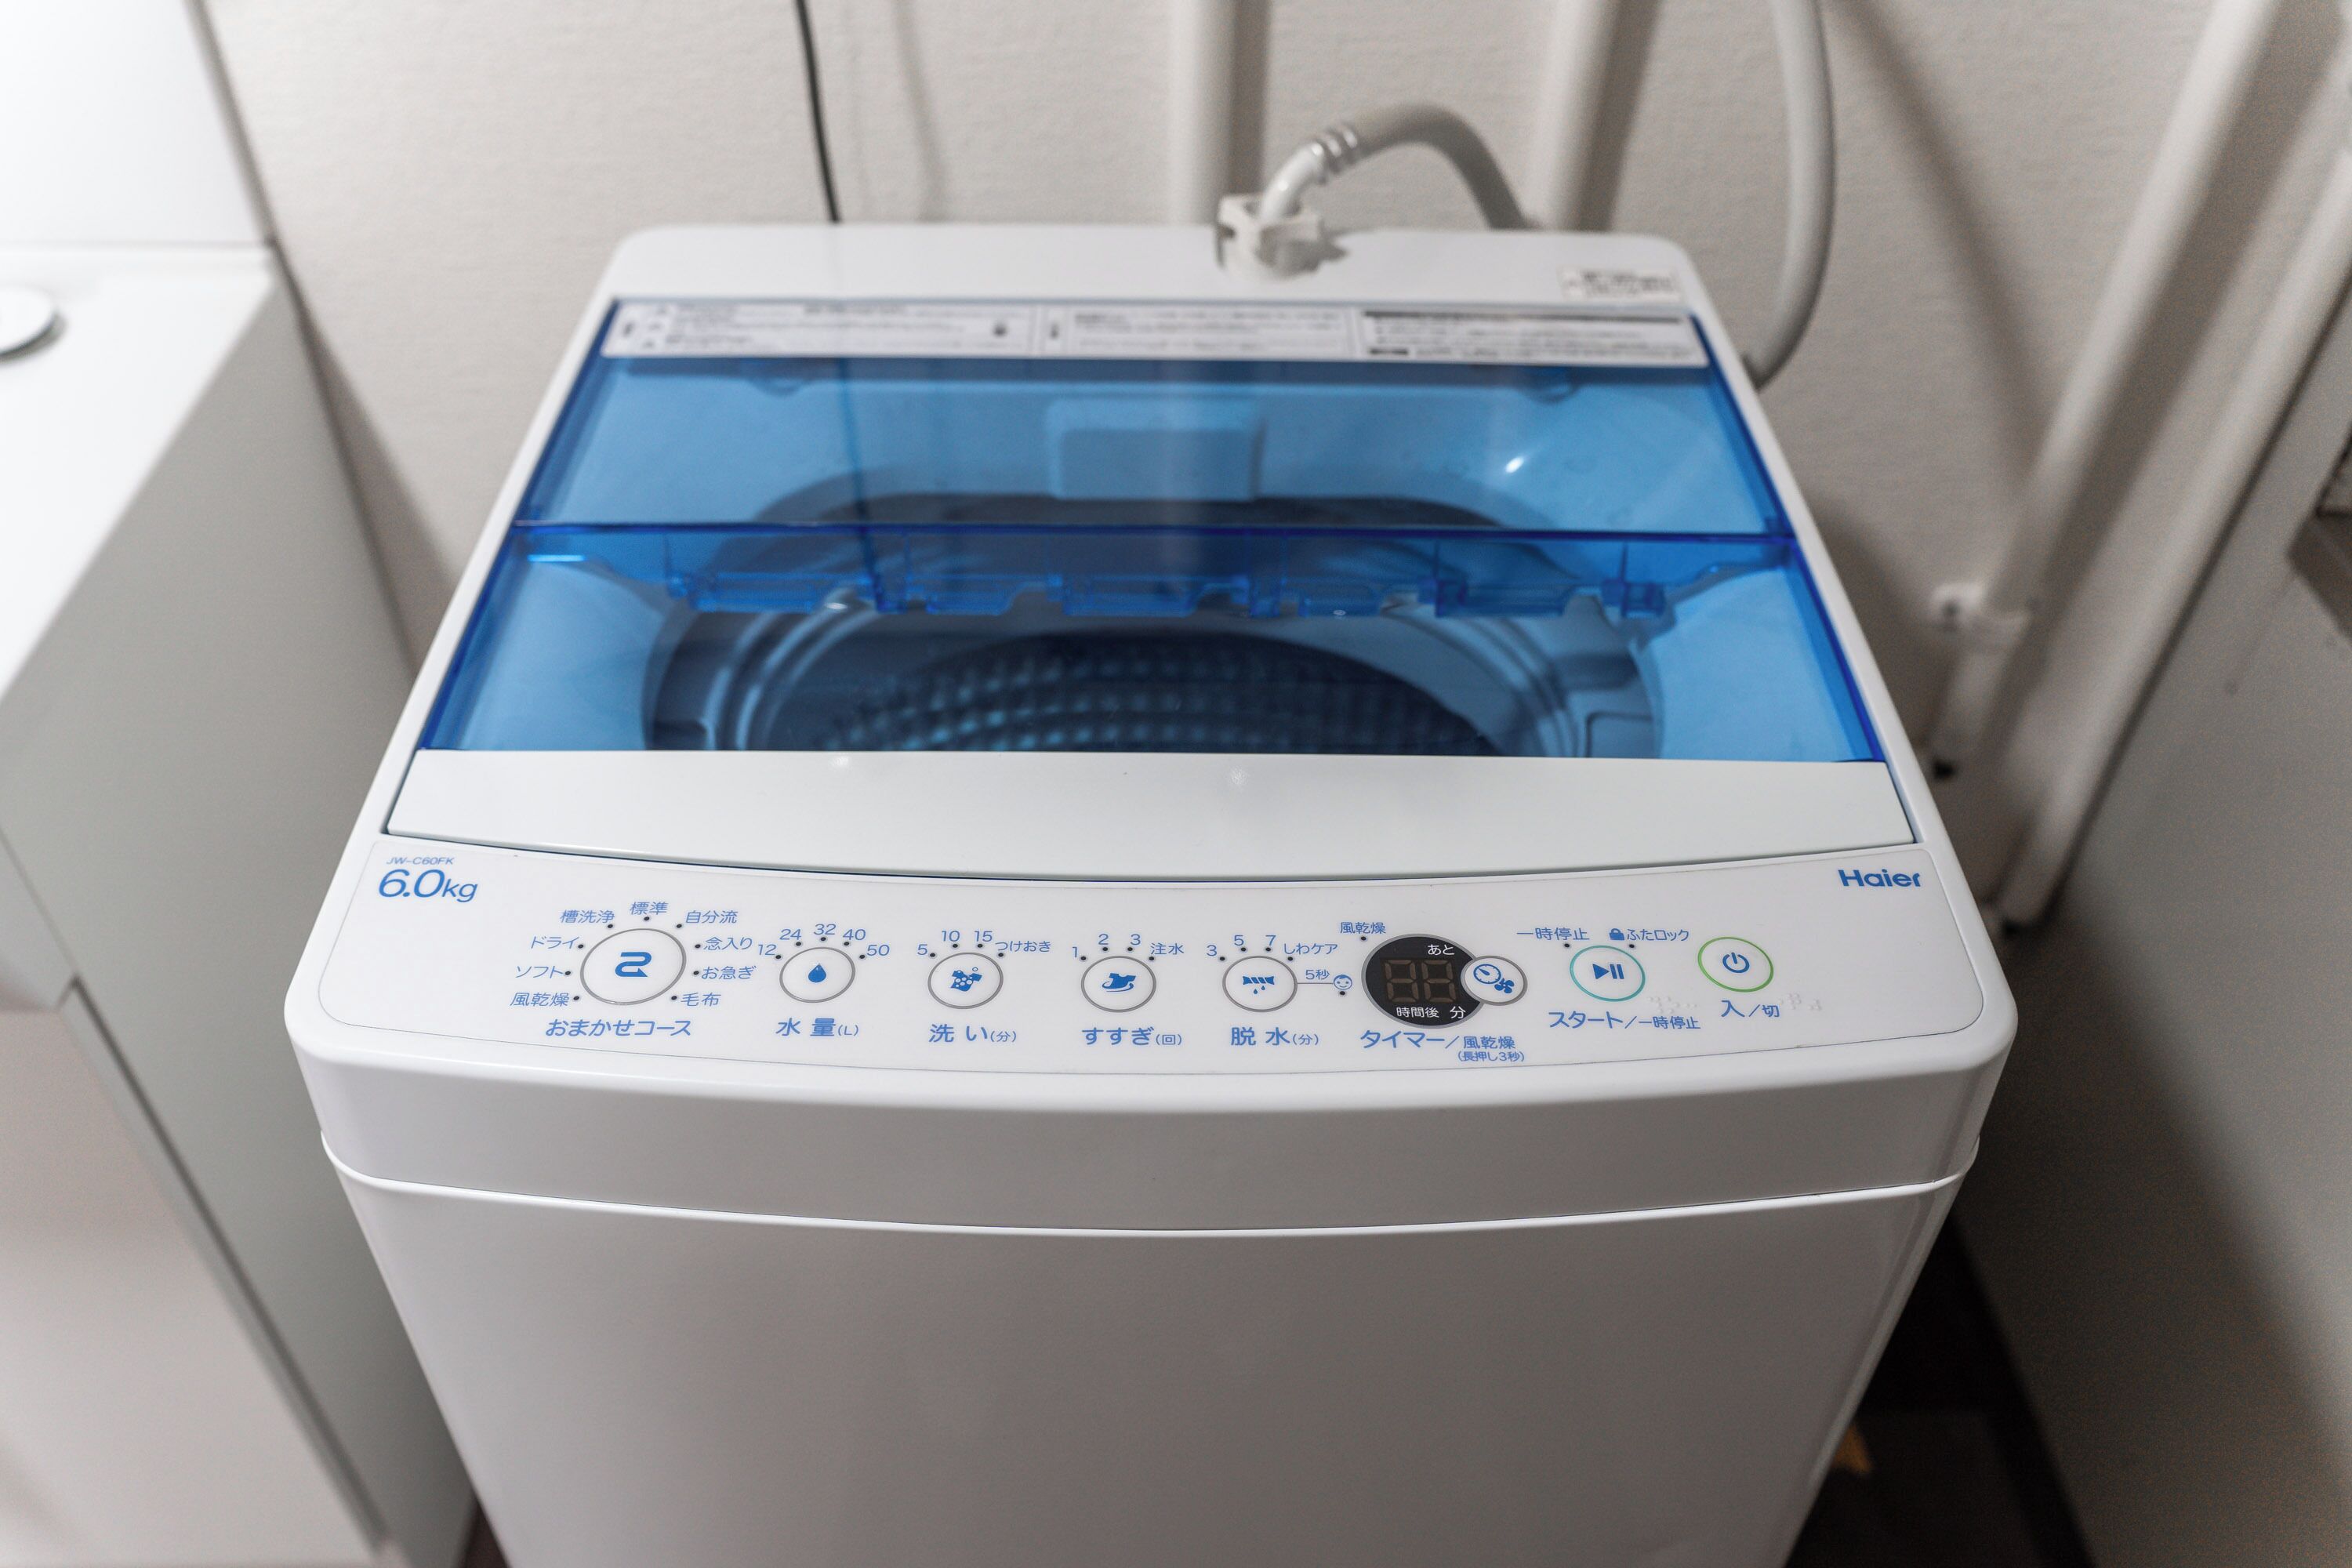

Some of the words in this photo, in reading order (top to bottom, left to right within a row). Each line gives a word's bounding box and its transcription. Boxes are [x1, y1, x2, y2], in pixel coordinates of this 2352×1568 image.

[386, 856, 455, 866] JW-C60FK
[378, 869, 478, 903] 6.0kg
[1836, 867, 1922, 891] Haier
[629, 900, 669, 916] 標準
[559, 908, 615, 924] 槽洗浄
[684, 909, 738, 925] 自分流
[778, 927, 803, 942] 24
[814, 923, 837, 936] 32
[843, 927, 867, 942] 40
[942, 927, 962, 943] 10
[1338, 920, 1387, 935] 風乾燥
[1517, 927, 1591, 942] 一時停止
[1626, 928, 1690, 942] ふたロック
[530, 935, 579, 950] ドライ
[705, 936, 754, 951] 念入り
[974, 928, 994, 944] 15
[1097, 932, 1110, 947] 2
[1131, 933, 1142, 948] 3
[1232, 933, 1246, 948] 5
[1267, 933, 1277, 948] 7
[757, 942, 777, 957] 12
[866, 943, 891, 956] 50
[916, 942, 929, 957] 5
[995, 940, 1051, 953] つけおき
[1072, 946, 1080, 958] 1
[1150, 942, 1184, 956] 注水
[1207, 943, 1218, 958] 3
[1282, 942, 1339, 956] しわケア
[1427, 942, 1457, 956] あと
[516, 965, 565, 979] ソフト
[701, 965, 757, 982] お急ぎ
[1304, 968, 1330, 982] 5秒
[509, 991, 572, 1007] 風乾燥
[681, 992, 720, 1009] 毛布
[1393, 1007, 1439, 1020] 時間後
[1449, 1006, 1469, 1021] 分
[543, 1017, 691, 1039] おまかせコース
